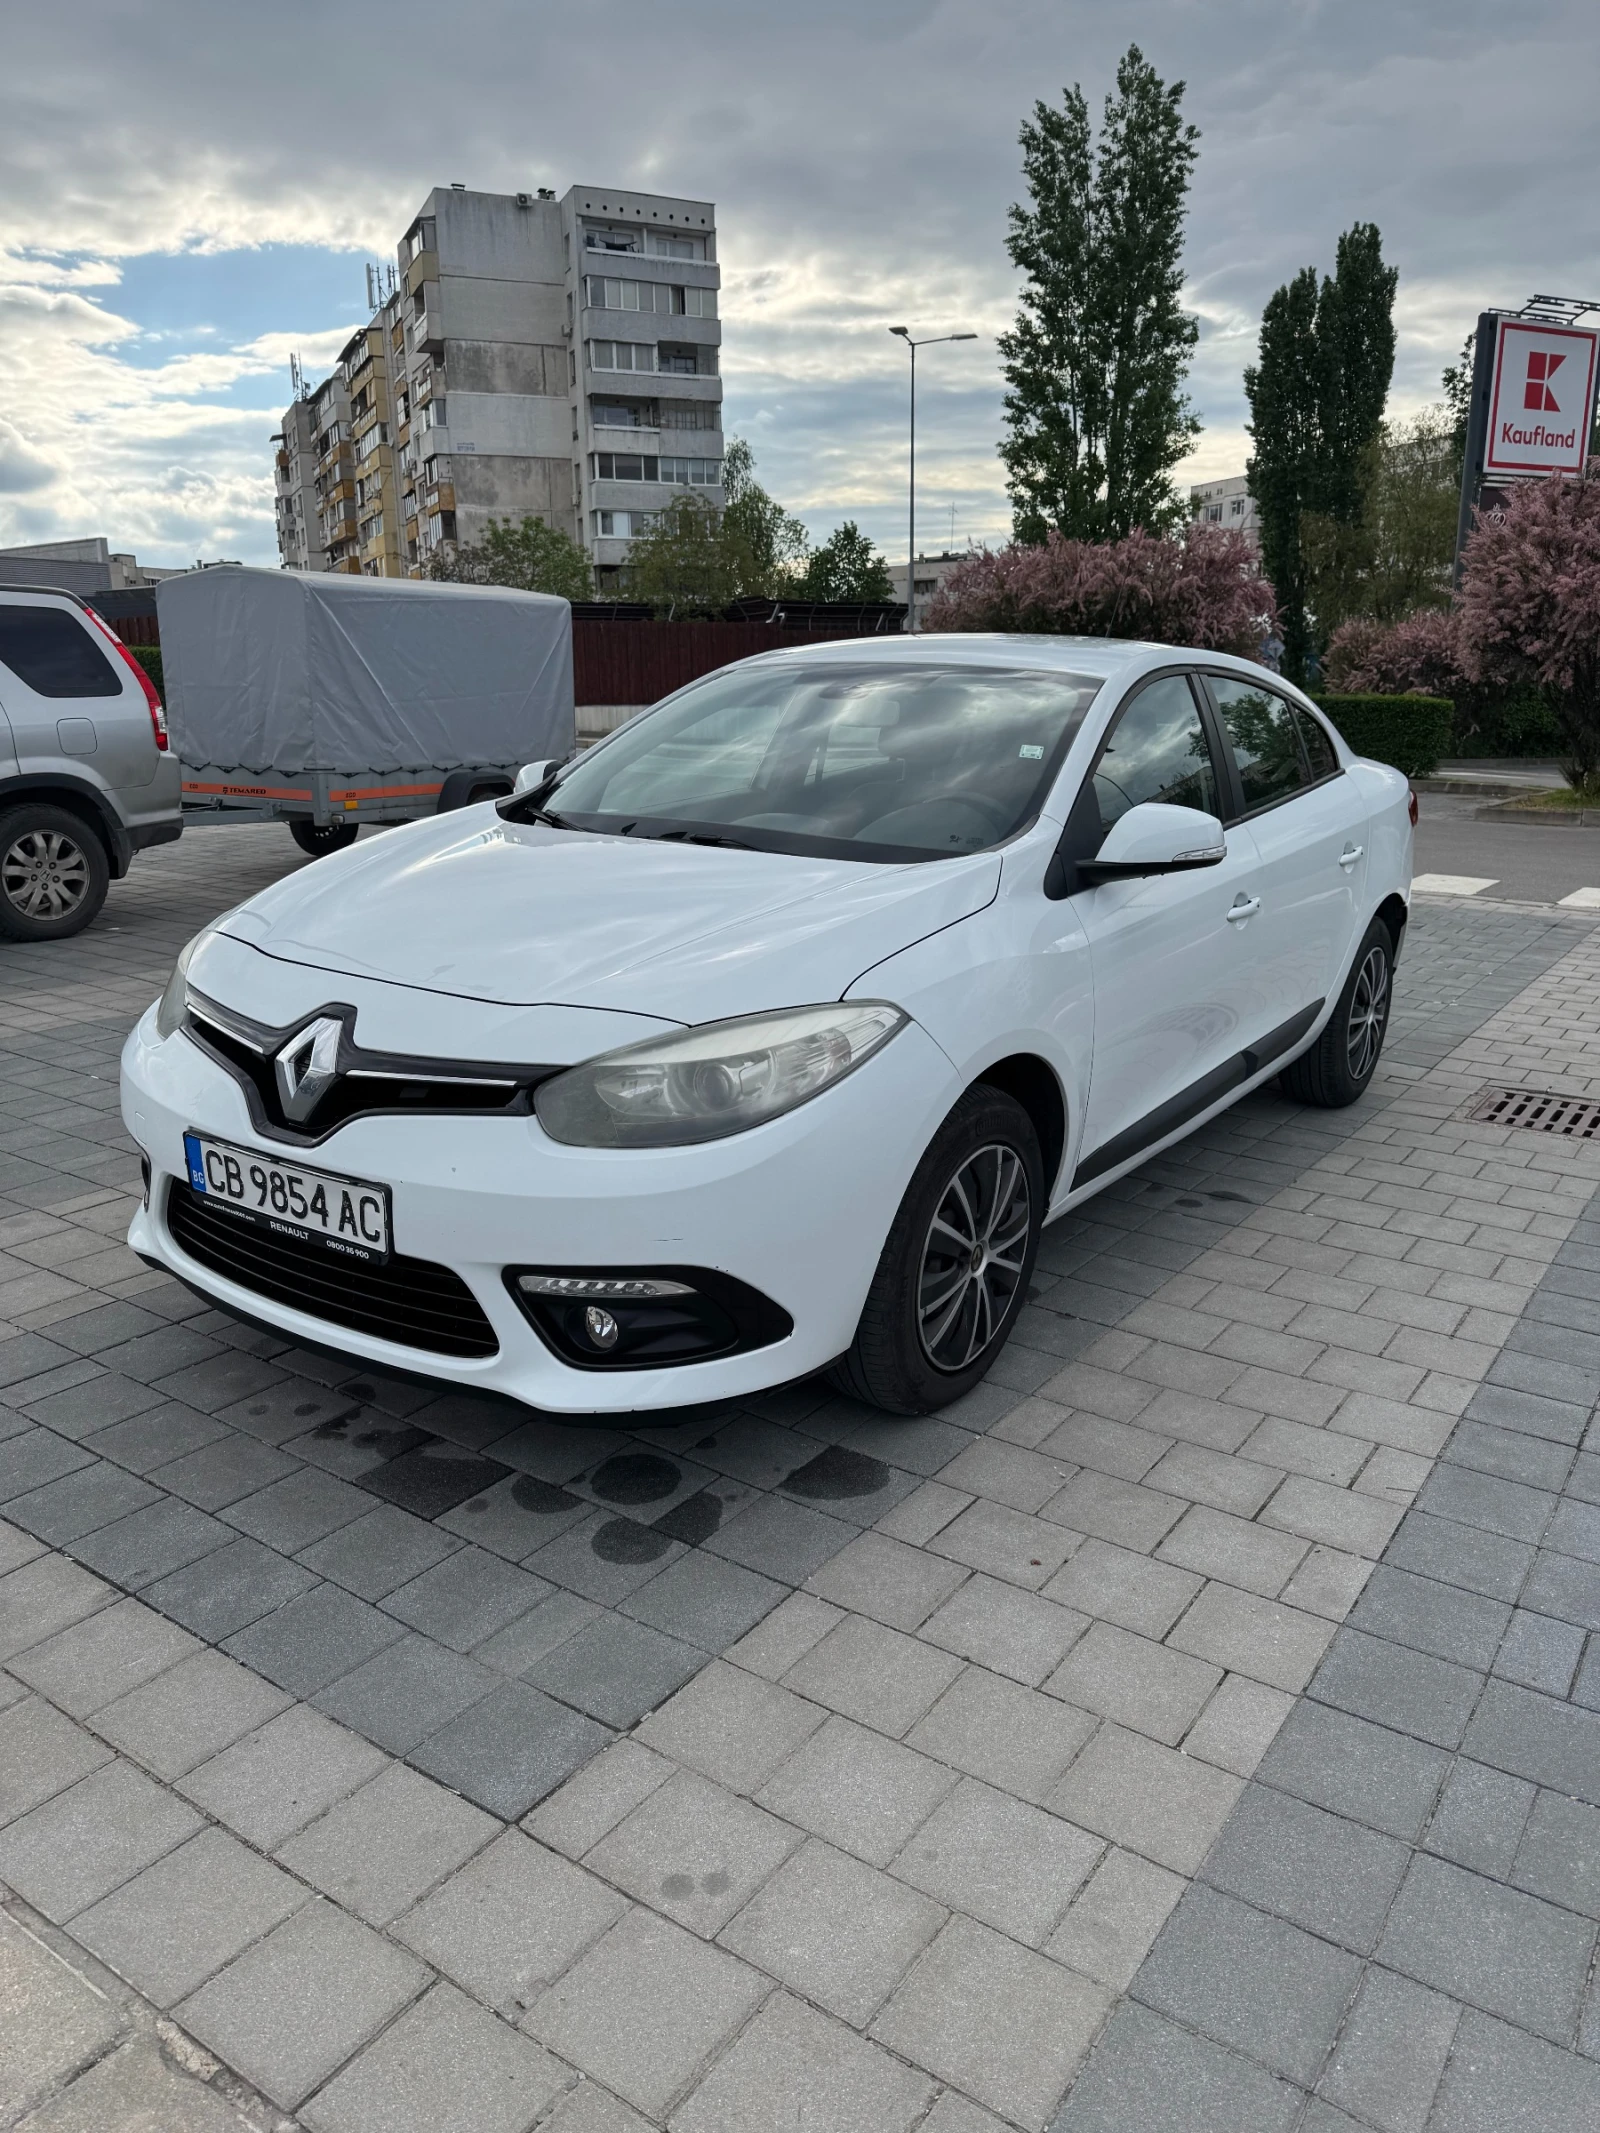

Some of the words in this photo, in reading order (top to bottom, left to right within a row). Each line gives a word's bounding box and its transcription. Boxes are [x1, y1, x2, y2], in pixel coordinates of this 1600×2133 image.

[1501, 422, 1576, 449] Kaufland
[229, 787, 267, 795] TEMARED
[192, 1169, 205, 1185] BG
[205, 1149, 245, 1199] CB
[249, 1164, 329, 1228] 9854
[338, 1189, 380, 1243] AC
[269, 1220, 309, 1241] RENAULT
